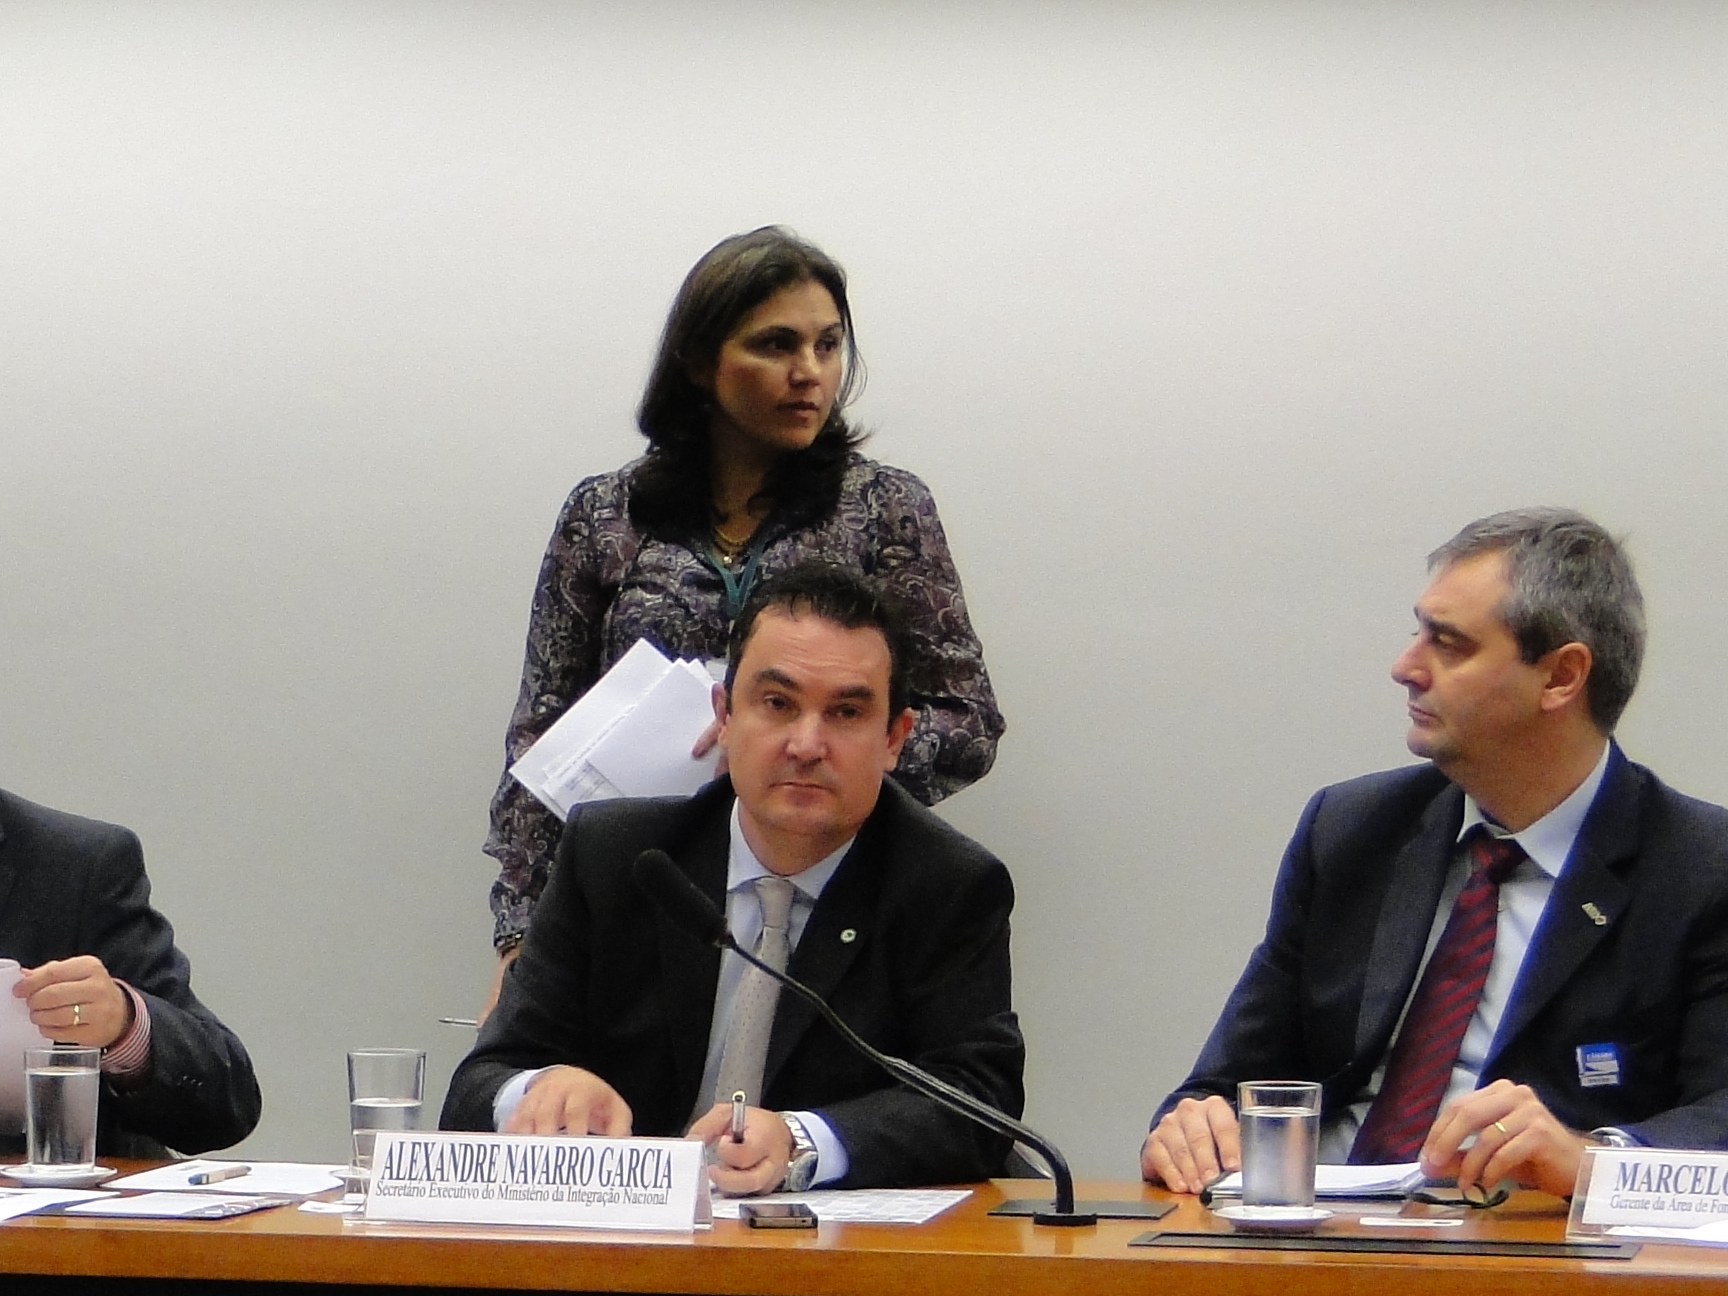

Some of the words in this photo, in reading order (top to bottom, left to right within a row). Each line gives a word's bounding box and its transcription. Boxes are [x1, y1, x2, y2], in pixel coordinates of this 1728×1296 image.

[381, 1140, 499, 1185] ALEXANDRE
[503, 1144, 594, 1187] NAVARRO
[375, 1180, 426, 1198] Secretário
[428, 1182, 480, 1199] Executivo
[482, 1184, 495, 1200] do
[498, 1184, 550, 1202] Ministério
[552, 1186, 565, 1202] da
[568, 1186, 620, 1207] Integração
[623, 1187, 669, 1206] Nacional
[1610, 1194, 1651, 1210] Gerente
[1653, 1196, 1665, 1211] da
[1695, 1199, 1708, 1213] de
